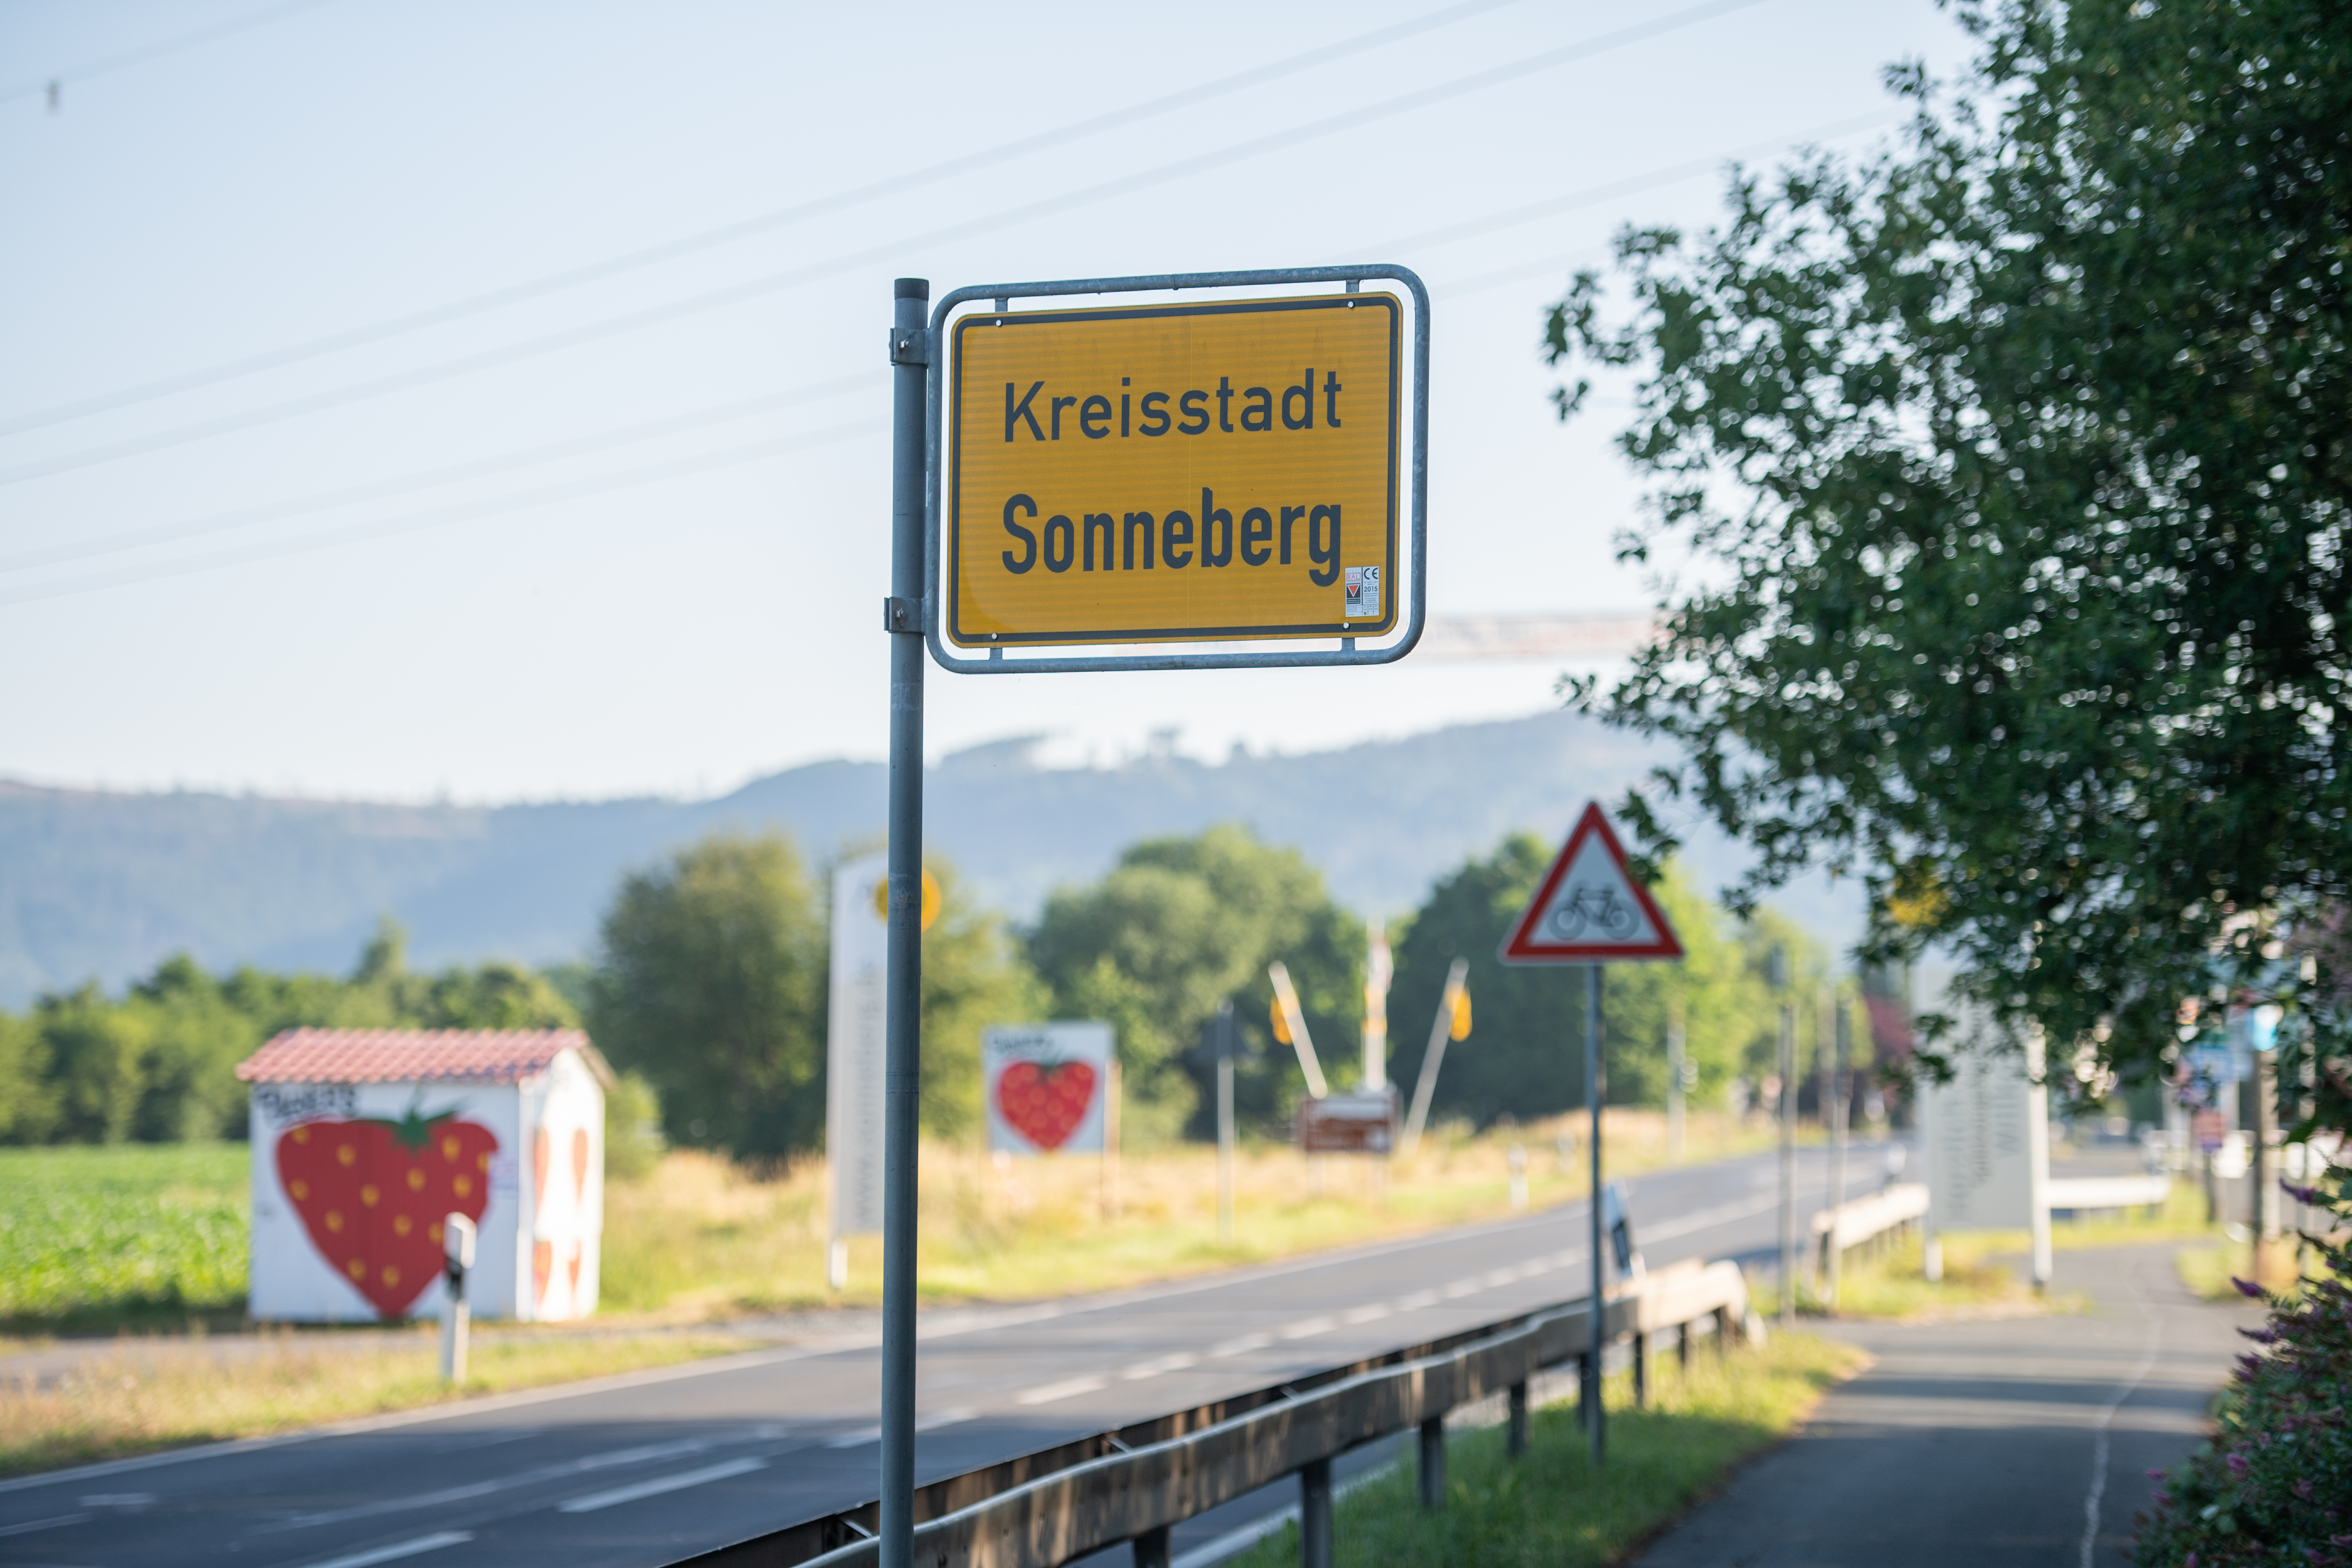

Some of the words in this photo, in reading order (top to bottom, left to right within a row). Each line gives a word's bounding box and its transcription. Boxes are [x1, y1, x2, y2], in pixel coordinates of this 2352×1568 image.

[1004, 368, 1342, 443] Kreisstadt
[1002, 487, 1342, 588] Sonneberg
[1364, 567, 1378, 580] CE
